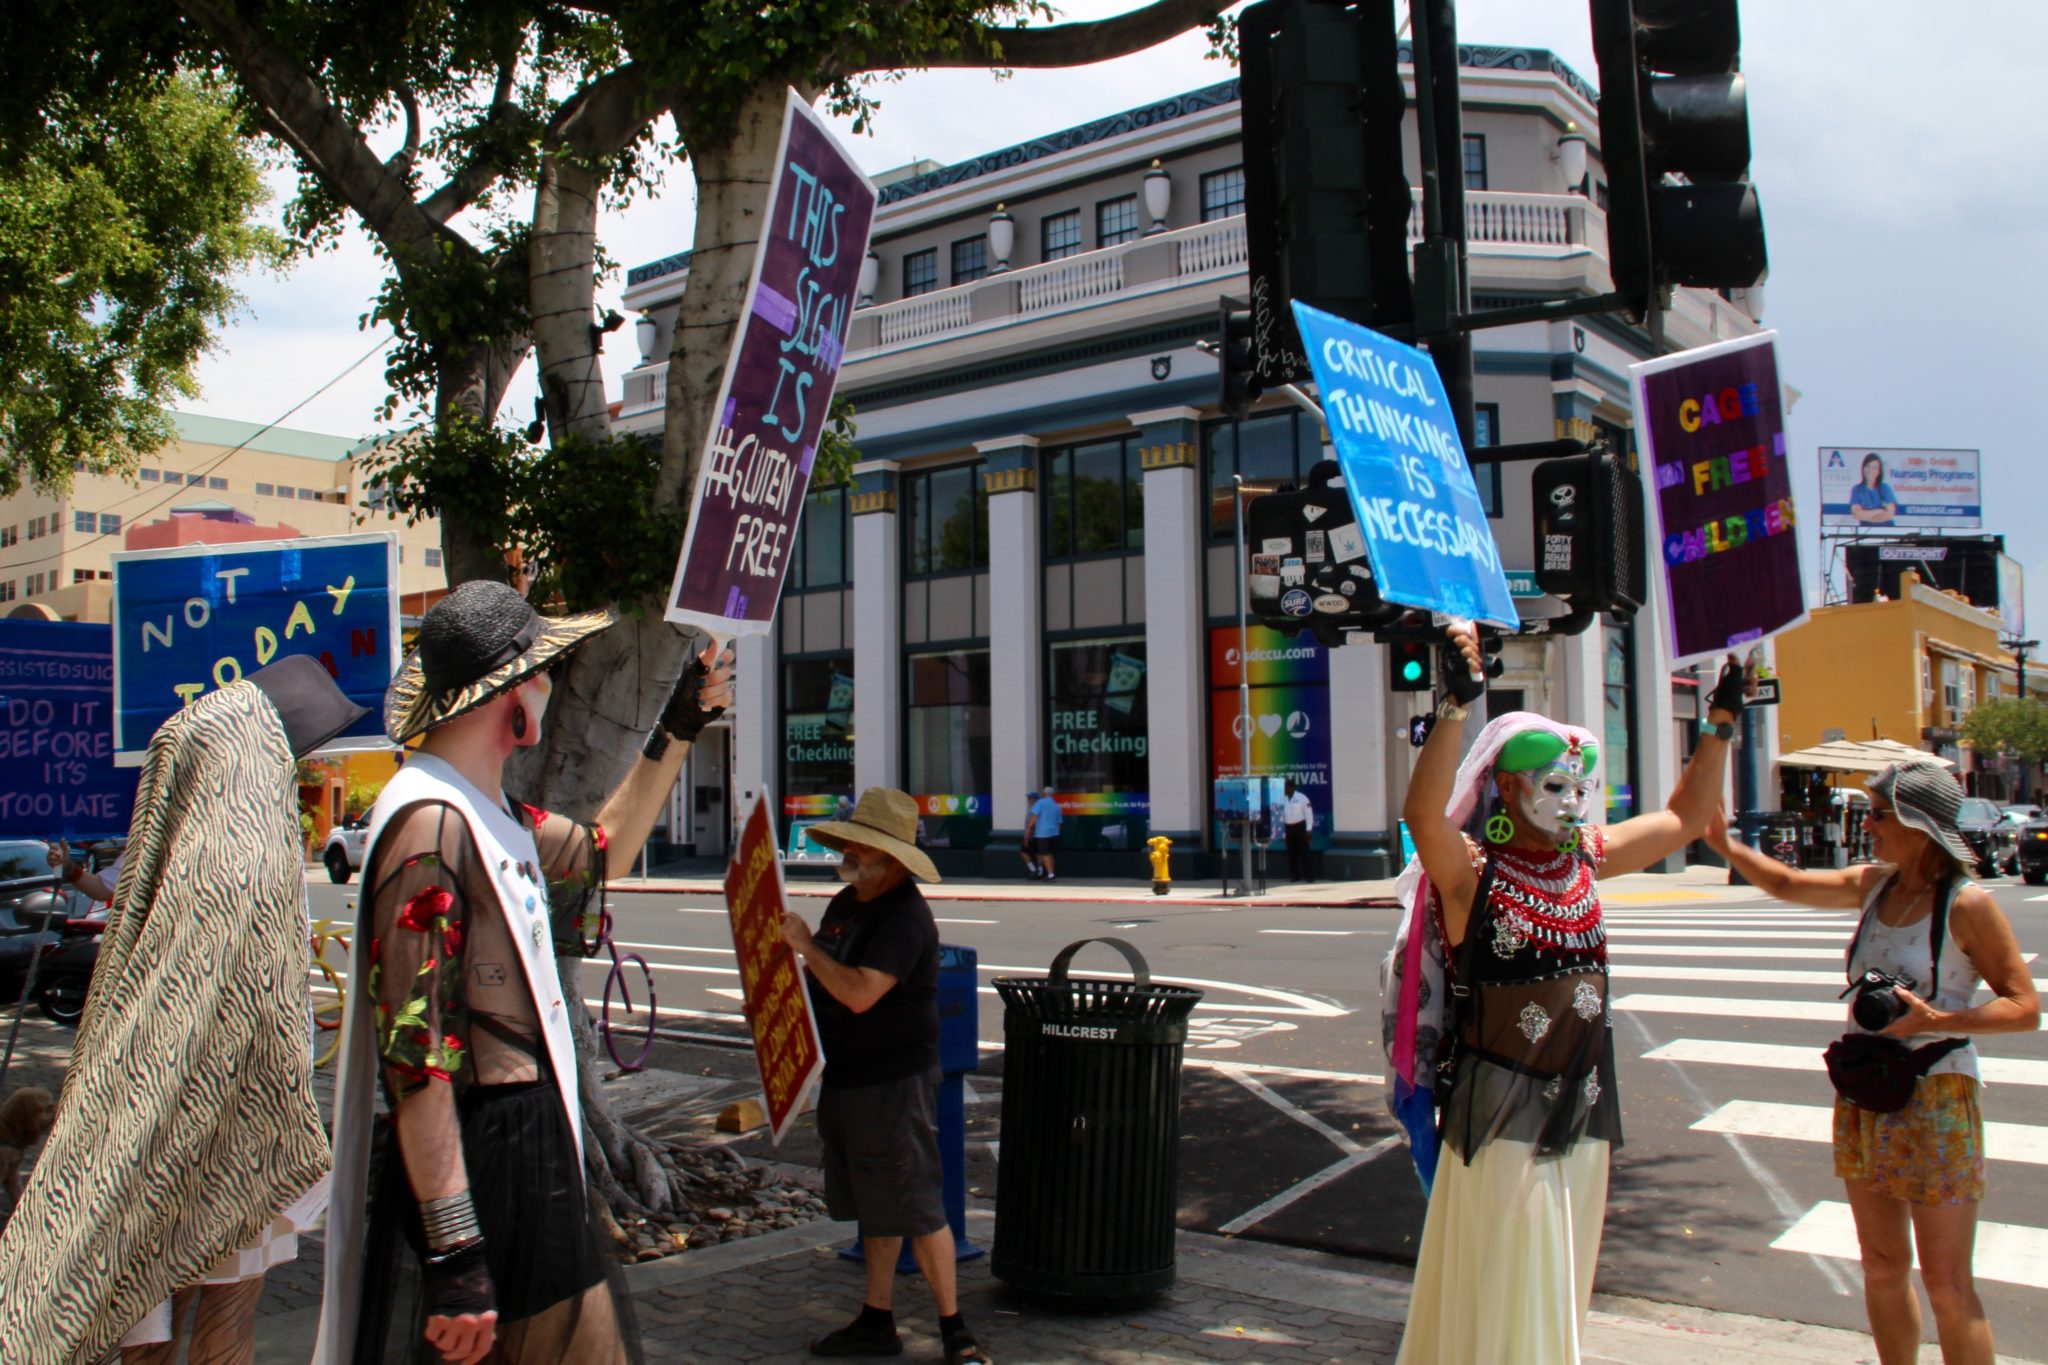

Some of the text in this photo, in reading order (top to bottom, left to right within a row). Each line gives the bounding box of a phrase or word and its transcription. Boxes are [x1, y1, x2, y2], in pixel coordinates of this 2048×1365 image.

[789, 161, 845, 268] THIS
[780, 267, 847, 376] SIGN
[1323, 337, 1435, 407] CRITICAL
[762, 357, 813, 443] IS
[1679, 383, 1759, 433] CAGE
[1328, 389, 1461, 469] THINKING
[705, 424, 798, 517] #GLUTEN
[1401, 454, 1436, 499] IS
[1692, 444, 1770, 496] FREE
[1890, 468, 1975, 482] Nursing Programs
[726, 514, 787, 578] FREE
[1359, 496, 1498, 573] NECESSARY
[1663, 496, 1797, 566] CHILDREN
[1883, 549, 1944, 559] OUTFRONT
[142, 567, 249, 652] NOT
[1284, 597, 1307, 608] SURF
[174, 575, 355, 707] TODAY
[9, 699, 100, 727] DO IT
[786, 724, 821, 741] FREE
[1052, 710, 1098, 730] FREE
[0, 728, 110, 760] BEFORE
[1052, 733, 1147, 758] Checking
[45, 760, 87, 785] IT'S
[0, 792, 120, 819] TOO LATE
[1042, 1023, 1117, 1039] HILLCREST
